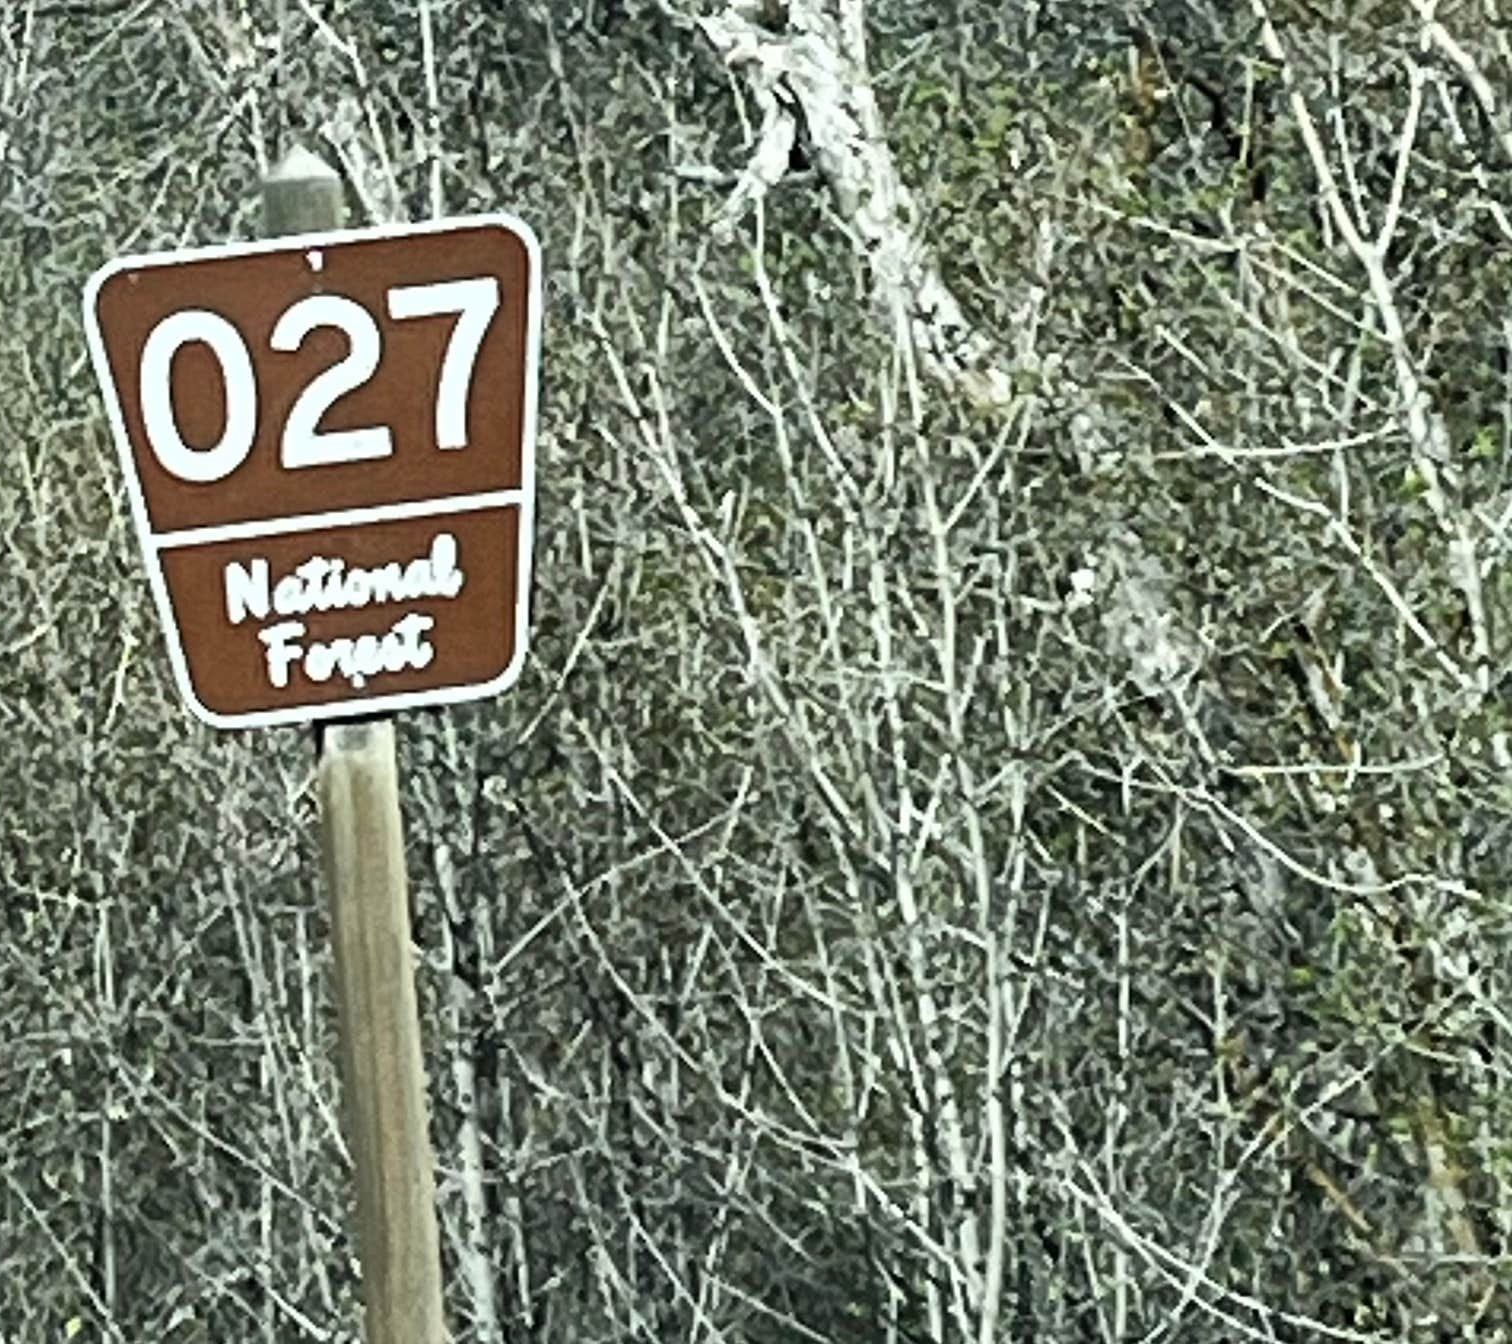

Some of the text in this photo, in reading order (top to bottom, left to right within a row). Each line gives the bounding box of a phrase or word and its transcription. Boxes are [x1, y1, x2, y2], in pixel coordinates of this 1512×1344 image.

[140, 276, 500, 482] 027
[225, 533, 464, 624] National
[257, 613, 435, 688] Forest
